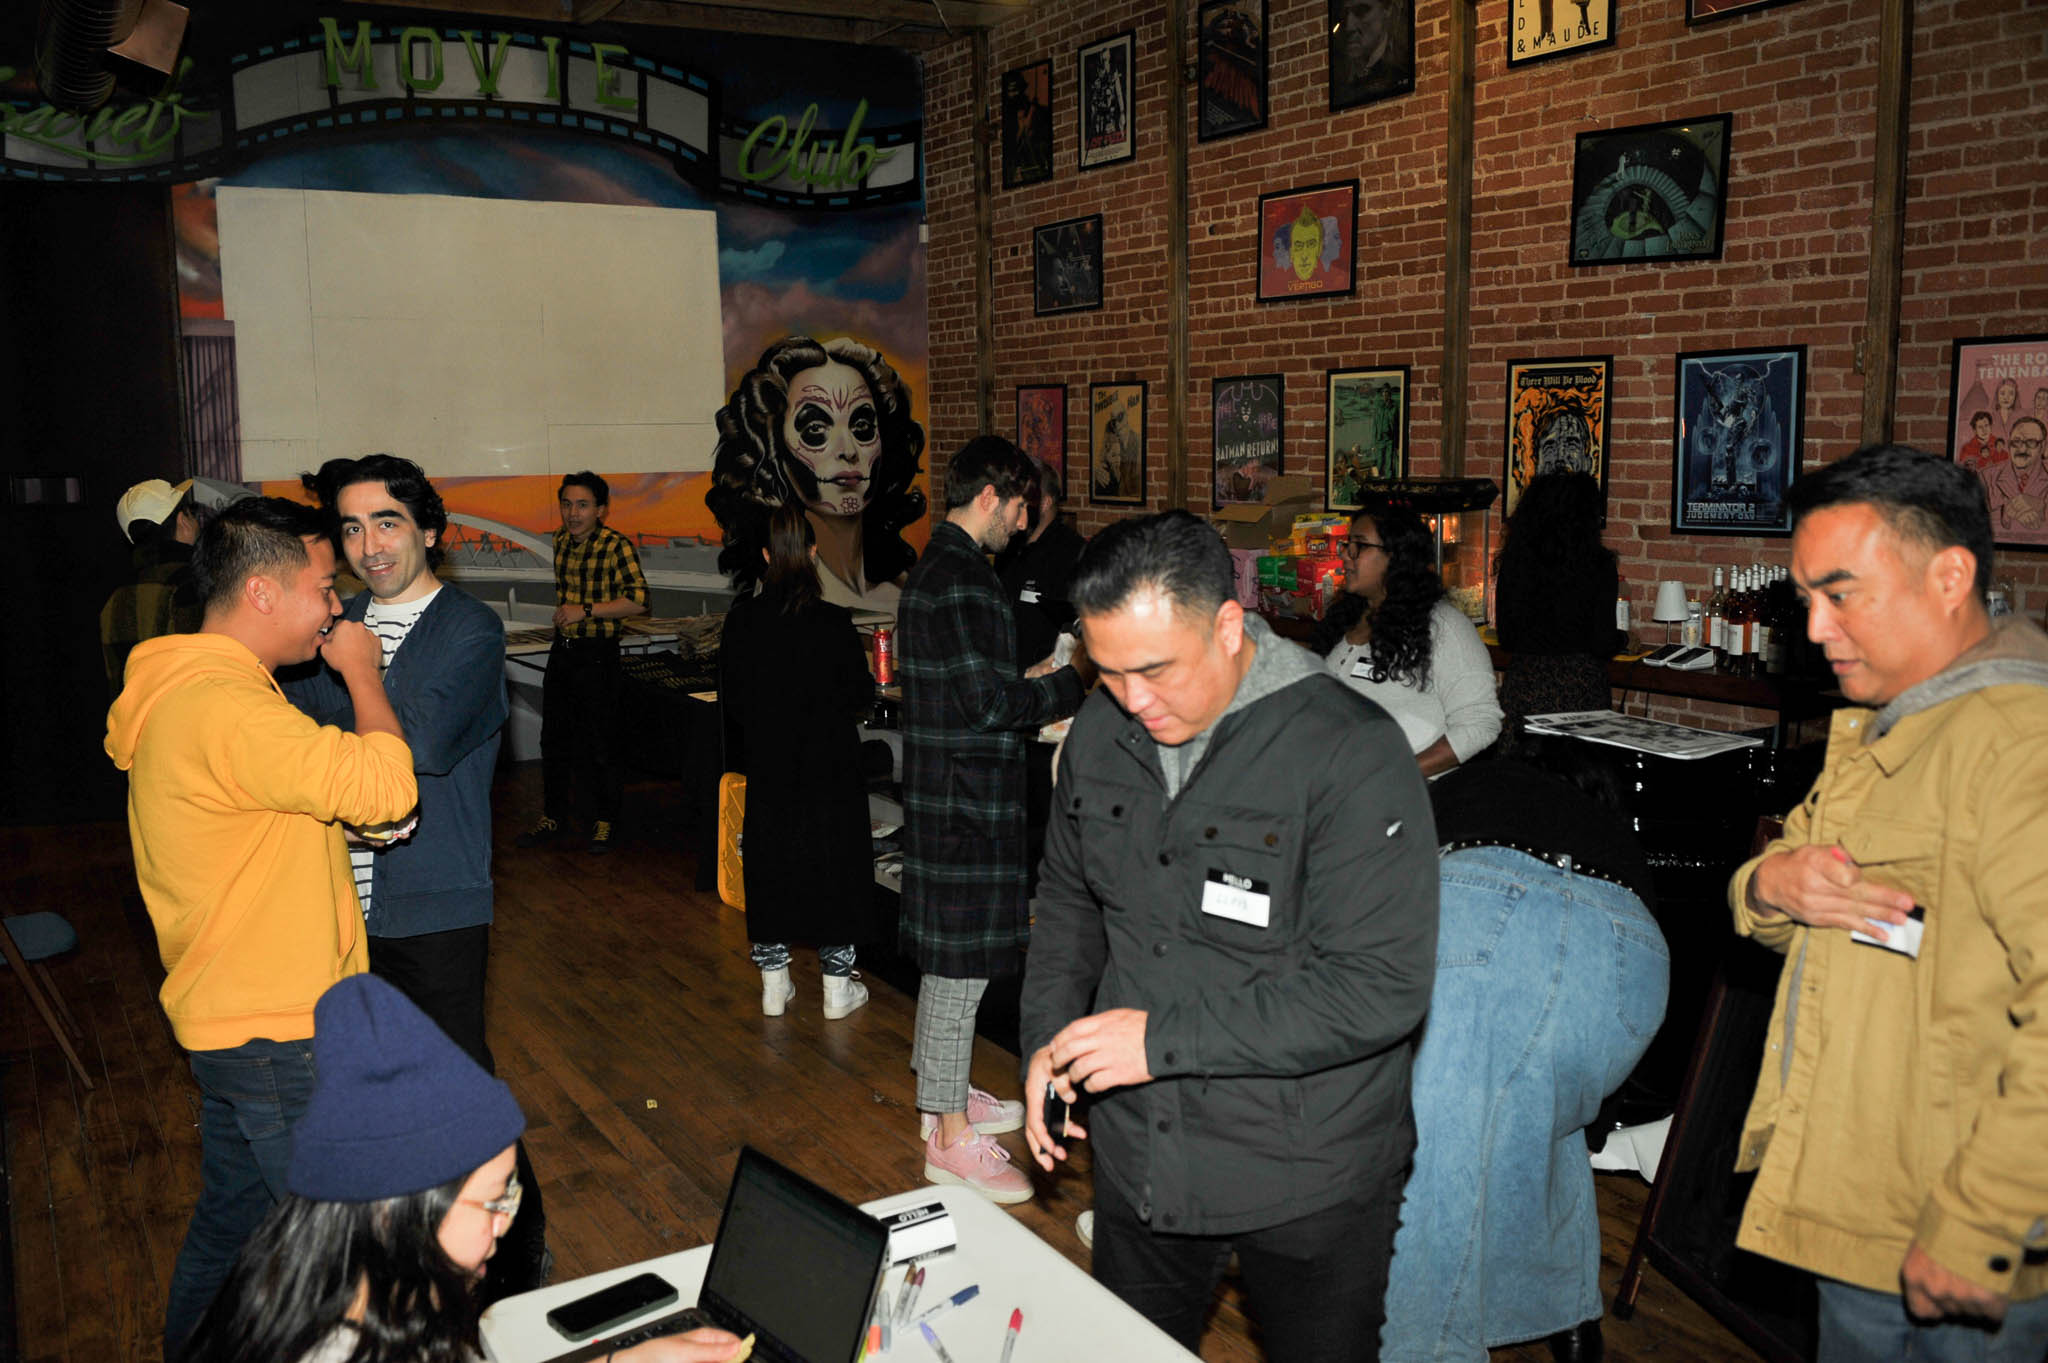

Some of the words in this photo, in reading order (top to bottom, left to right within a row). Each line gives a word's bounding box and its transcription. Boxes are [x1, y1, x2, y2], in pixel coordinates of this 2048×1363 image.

[1517, 39, 1526, 53] &
[1533, 21, 1599, 49] MAUDE
[319, 16, 637, 109] MOVIE
[737, 97, 897, 190] Club
[1992, 351, 2020, 367] THE
[1215, 441, 1246, 461] BATMAN
[1687, 502, 1746, 512] TERMINATOR
[898, 1207, 929, 1223] HELLO
